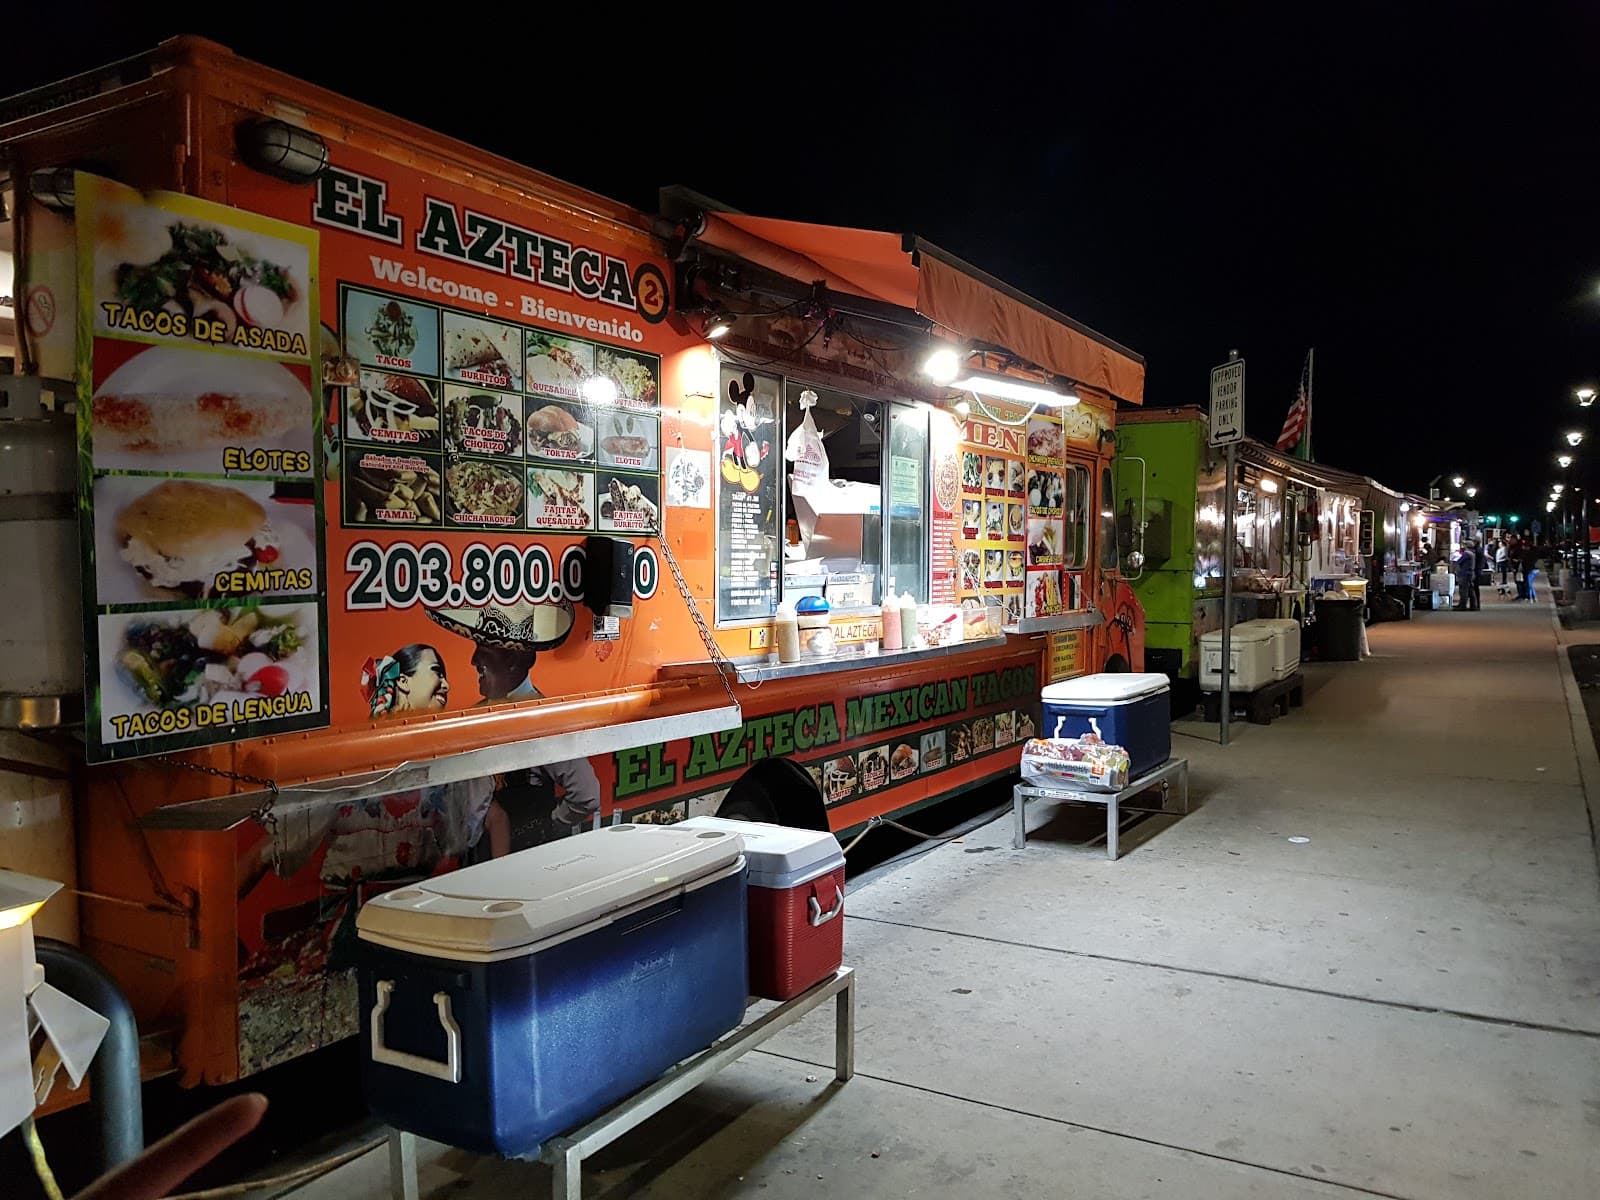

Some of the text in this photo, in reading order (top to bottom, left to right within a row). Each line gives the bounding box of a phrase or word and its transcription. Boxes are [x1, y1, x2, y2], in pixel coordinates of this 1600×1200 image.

[313, 167, 401, 245] EL
[417, 197, 637, 311] AZTECA
[370, 256, 498, 308] Welcome
[520, 295, 644, 343] Bienvenido
[102, 302, 308, 355] TACOS DE ASADA
[375, 354, 412, 369] TACOS
[460, 369, 507, 385] BURRITOS
[1214, 366, 1241, 383] APPROVED
[532, 382, 578, 397] QUESADILL
[1215, 397, 1238, 411] PARKING
[1218, 413, 1234, 426] ONLY
[370, 427, 420, 442] CEMITAS
[462, 427, 506, 440] TACOS DE
[464, 438, 505, 451] CHORIZO
[222, 447, 311, 473] ELOTES
[545, 449, 577, 459] TORTAS
[615, 456, 641, 466] ELOTES
[376, 510, 416, 520] TAMAL
[544, 505, 577, 514] FAJITAS
[614, 511, 643, 519] FAJITAS
[452, 515, 516, 524] CHICHARRONES
[536, 516, 585, 526] QUESADILLA
[614, 520, 643, 529] BURRITO
[214, 568, 312, 592] CEMITAS
[346, 542, 658, 610] 203.800.00
[834, 623, 878, 639] AL AZTECA
[112, 690, 312, 738] TACOS DE LENGUA
[615, 664, 1036, 798] EL AZTECA MEXICAN TACOS
